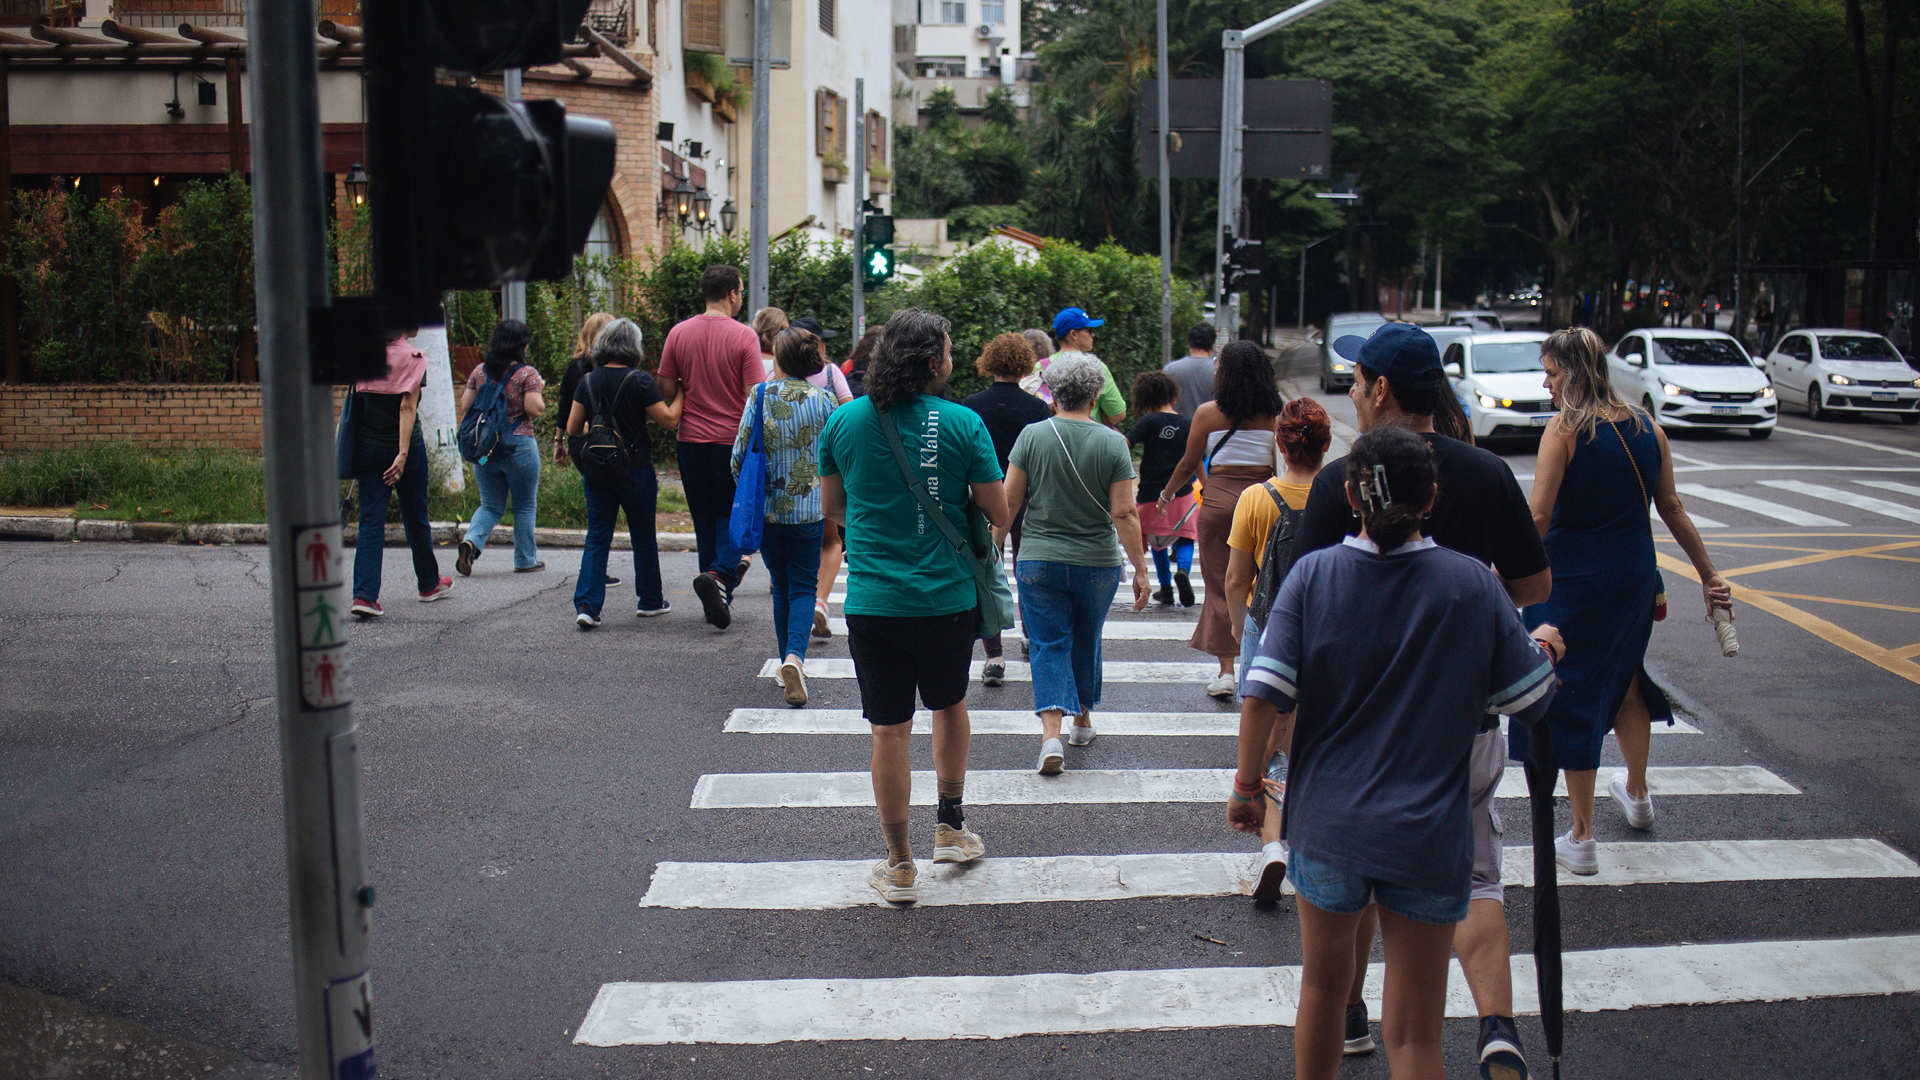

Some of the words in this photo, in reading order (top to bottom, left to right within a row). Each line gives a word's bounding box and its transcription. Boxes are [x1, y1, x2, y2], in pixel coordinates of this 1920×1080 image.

[920, 410, 939, 470] Klabin
[927, 476, 943, 511] ma
[917, 513, 925, 535] casa
